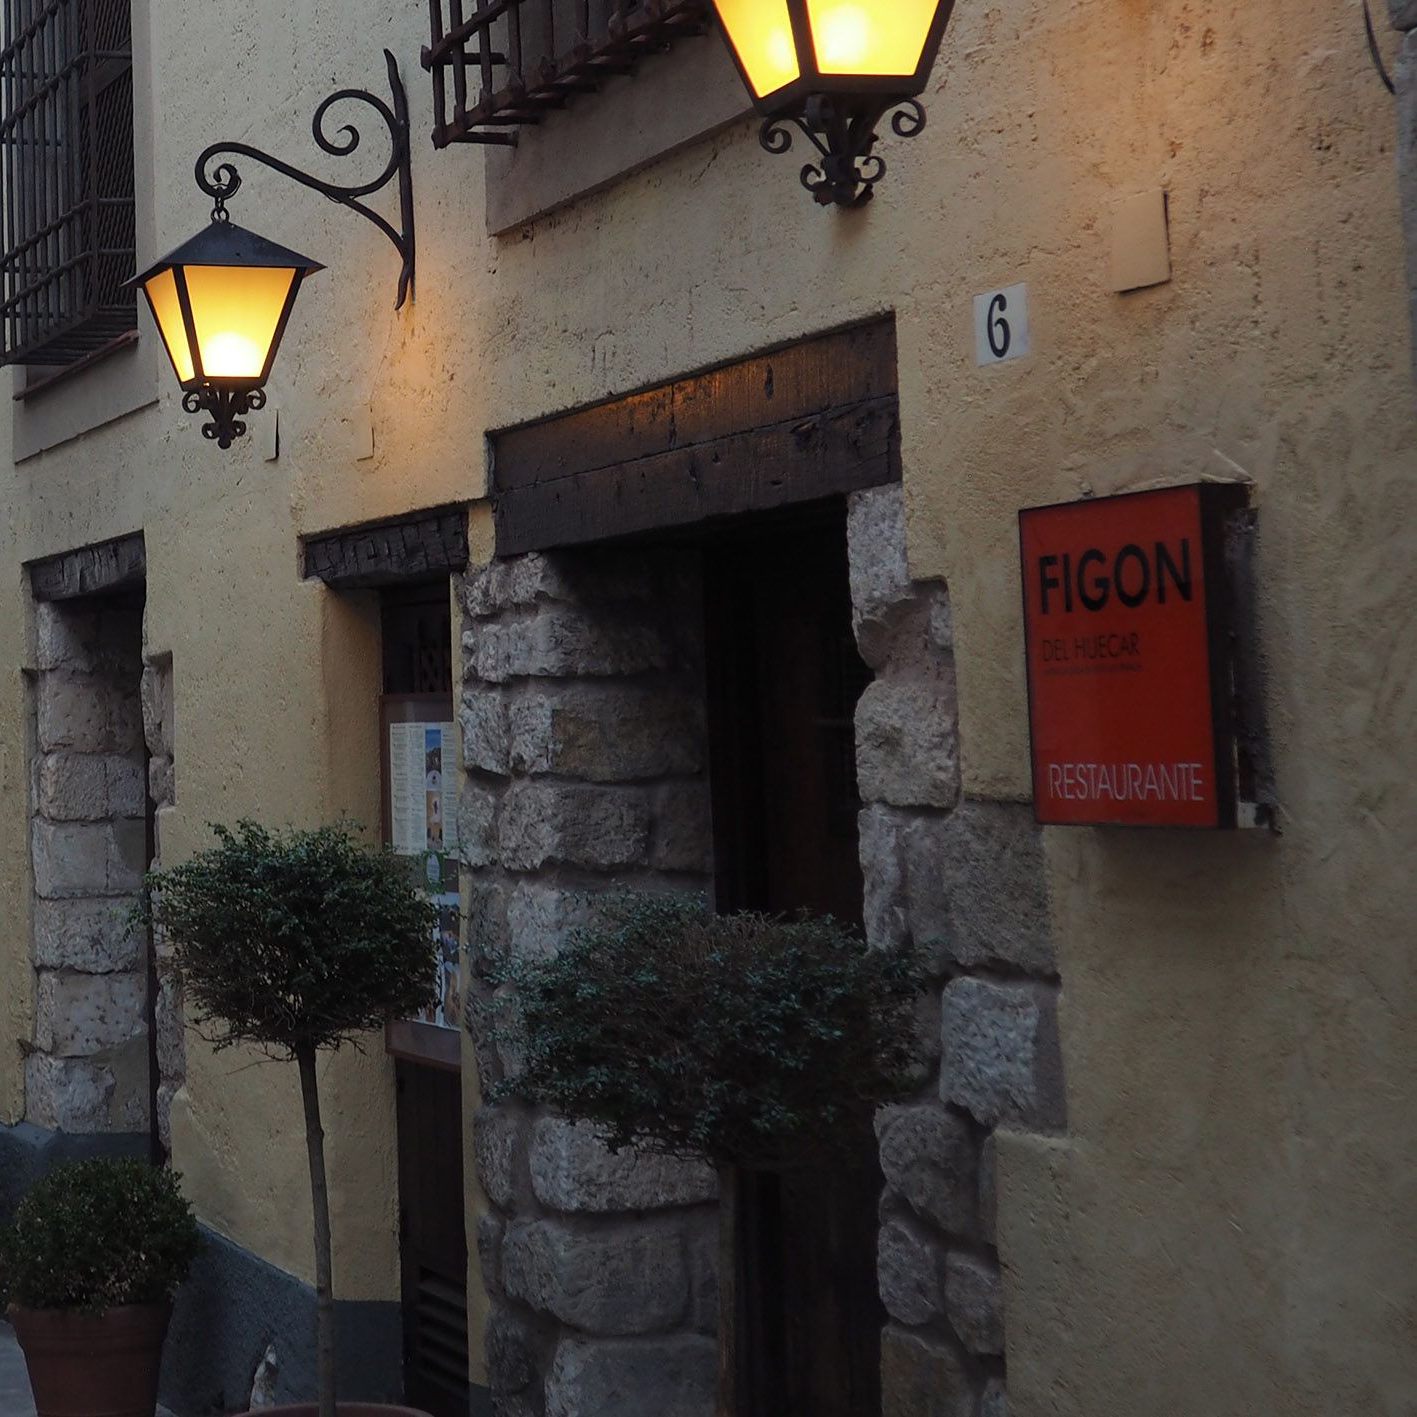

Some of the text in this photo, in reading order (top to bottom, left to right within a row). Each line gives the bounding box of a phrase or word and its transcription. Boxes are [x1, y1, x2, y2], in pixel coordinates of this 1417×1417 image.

[987, 293, 1011, 358] 6
[1039, 539, 1193, 614] FIGON
[1042, 632, 1140, 662] DEL HUECAR
[1049, 763, 1204, 801] RESTAURANTE
